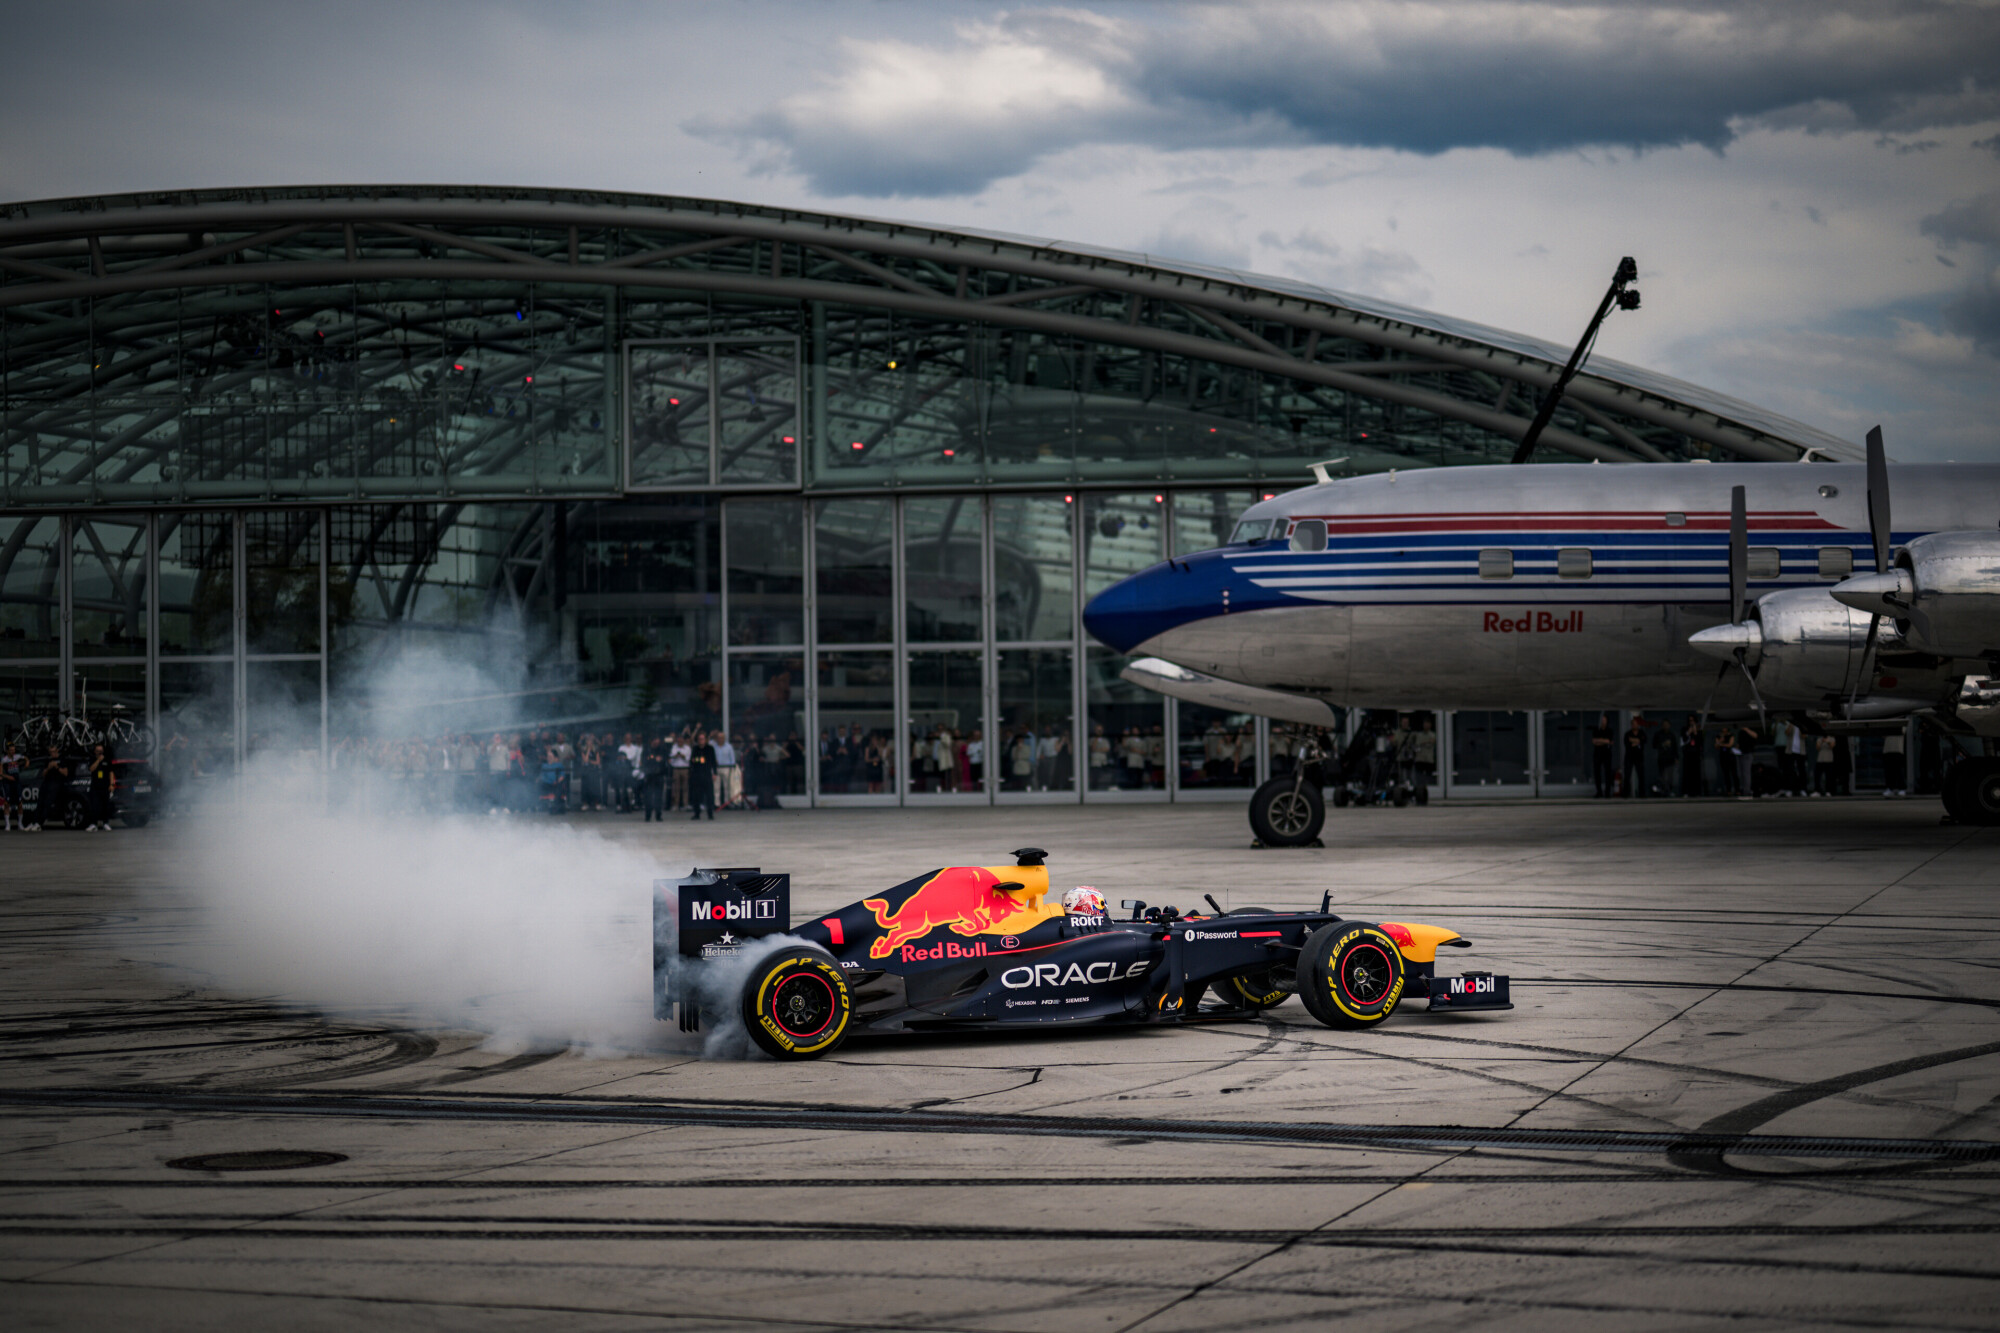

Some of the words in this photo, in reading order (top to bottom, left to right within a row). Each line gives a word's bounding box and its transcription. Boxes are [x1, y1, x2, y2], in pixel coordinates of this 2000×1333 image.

[1484, 611, 1531, 632] Red
[1537, 611, 1583, 632] Bull
[22, 787, 40, 800] OR
[692, 900, 751, 920] Mobil
[821, 918, 844, 944] 1
[1071, 916, 1104, 927] ROKT
[1196, 930, 1237, 939] 1Password
[902, 941, 943, 963] Red
[946, 941, 987, 958] Bull
[1328, 929, 1360, 971] ZERO
[798, 958, 813, 966] P
[817, 961, 849, 1010] ZERO
[1001, 960, 1150, 989] ORACLE
[1328, 976, 1337, 989] P
[1450, 977, 1495, 993] Mobil
[1382, 976, 1404, 1015] PIRELLI
[760, 1015, 795, 1051] PIRELLI
